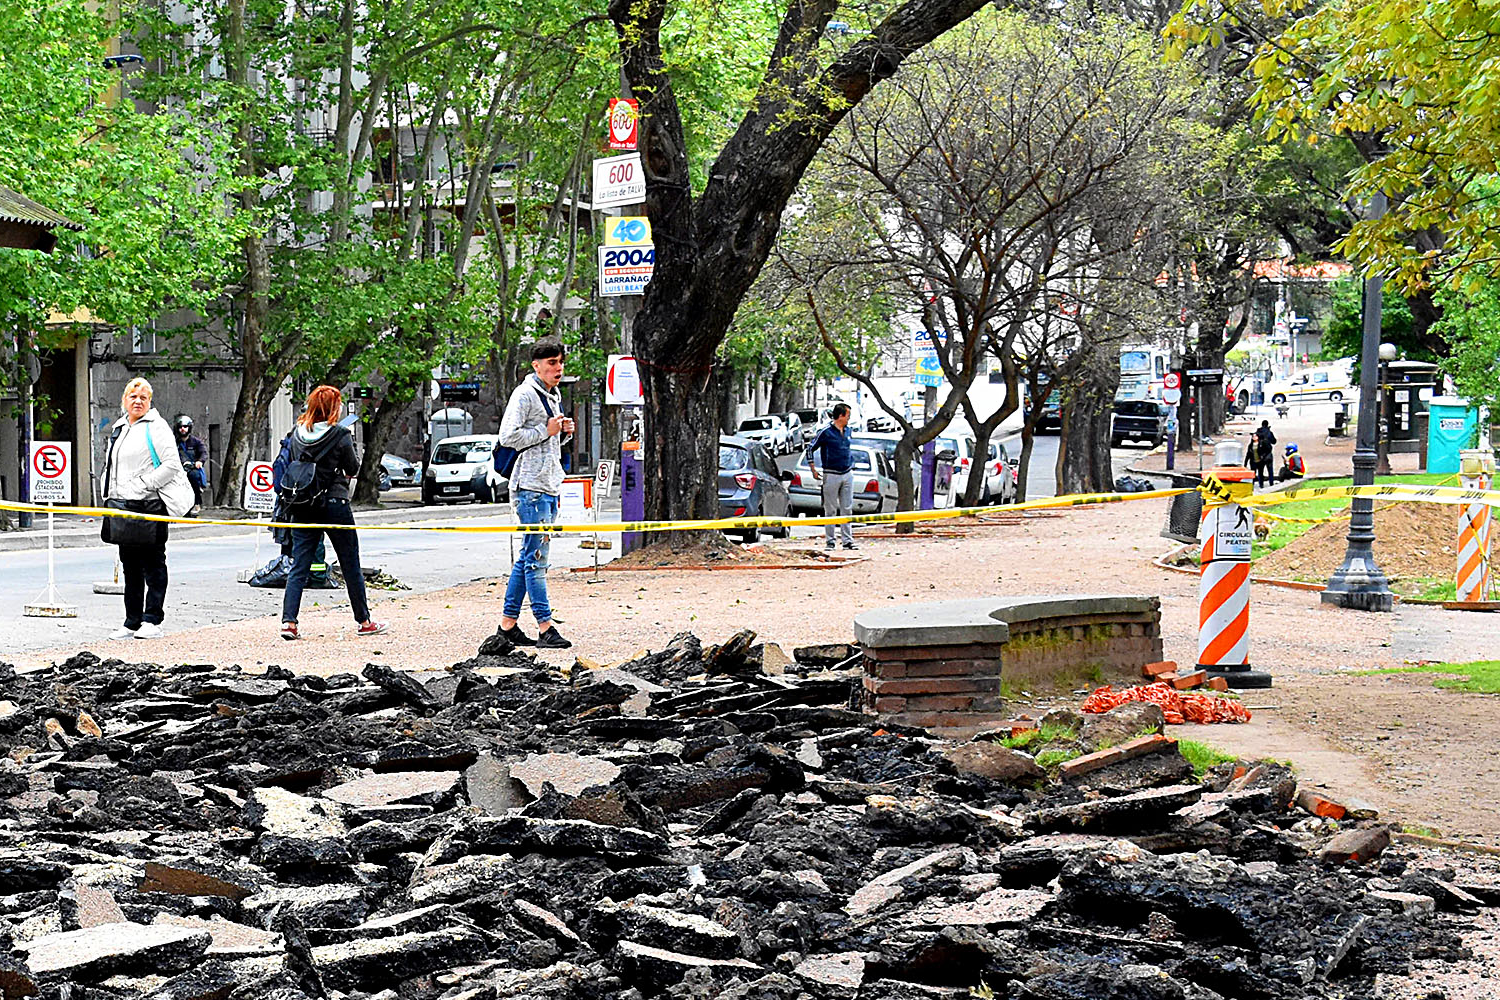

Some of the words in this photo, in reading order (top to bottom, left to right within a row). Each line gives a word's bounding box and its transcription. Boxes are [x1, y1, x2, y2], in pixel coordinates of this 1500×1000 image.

[609, 163, 633, 184] 600
[619, 187, 626, 196] de
[604, 249, 656, 267] 2004
[605, 275, 650, 284] LARRAÑAG
[605, 285, 621, 293] LUIS
[917, 375, 940, 385] LUIS
